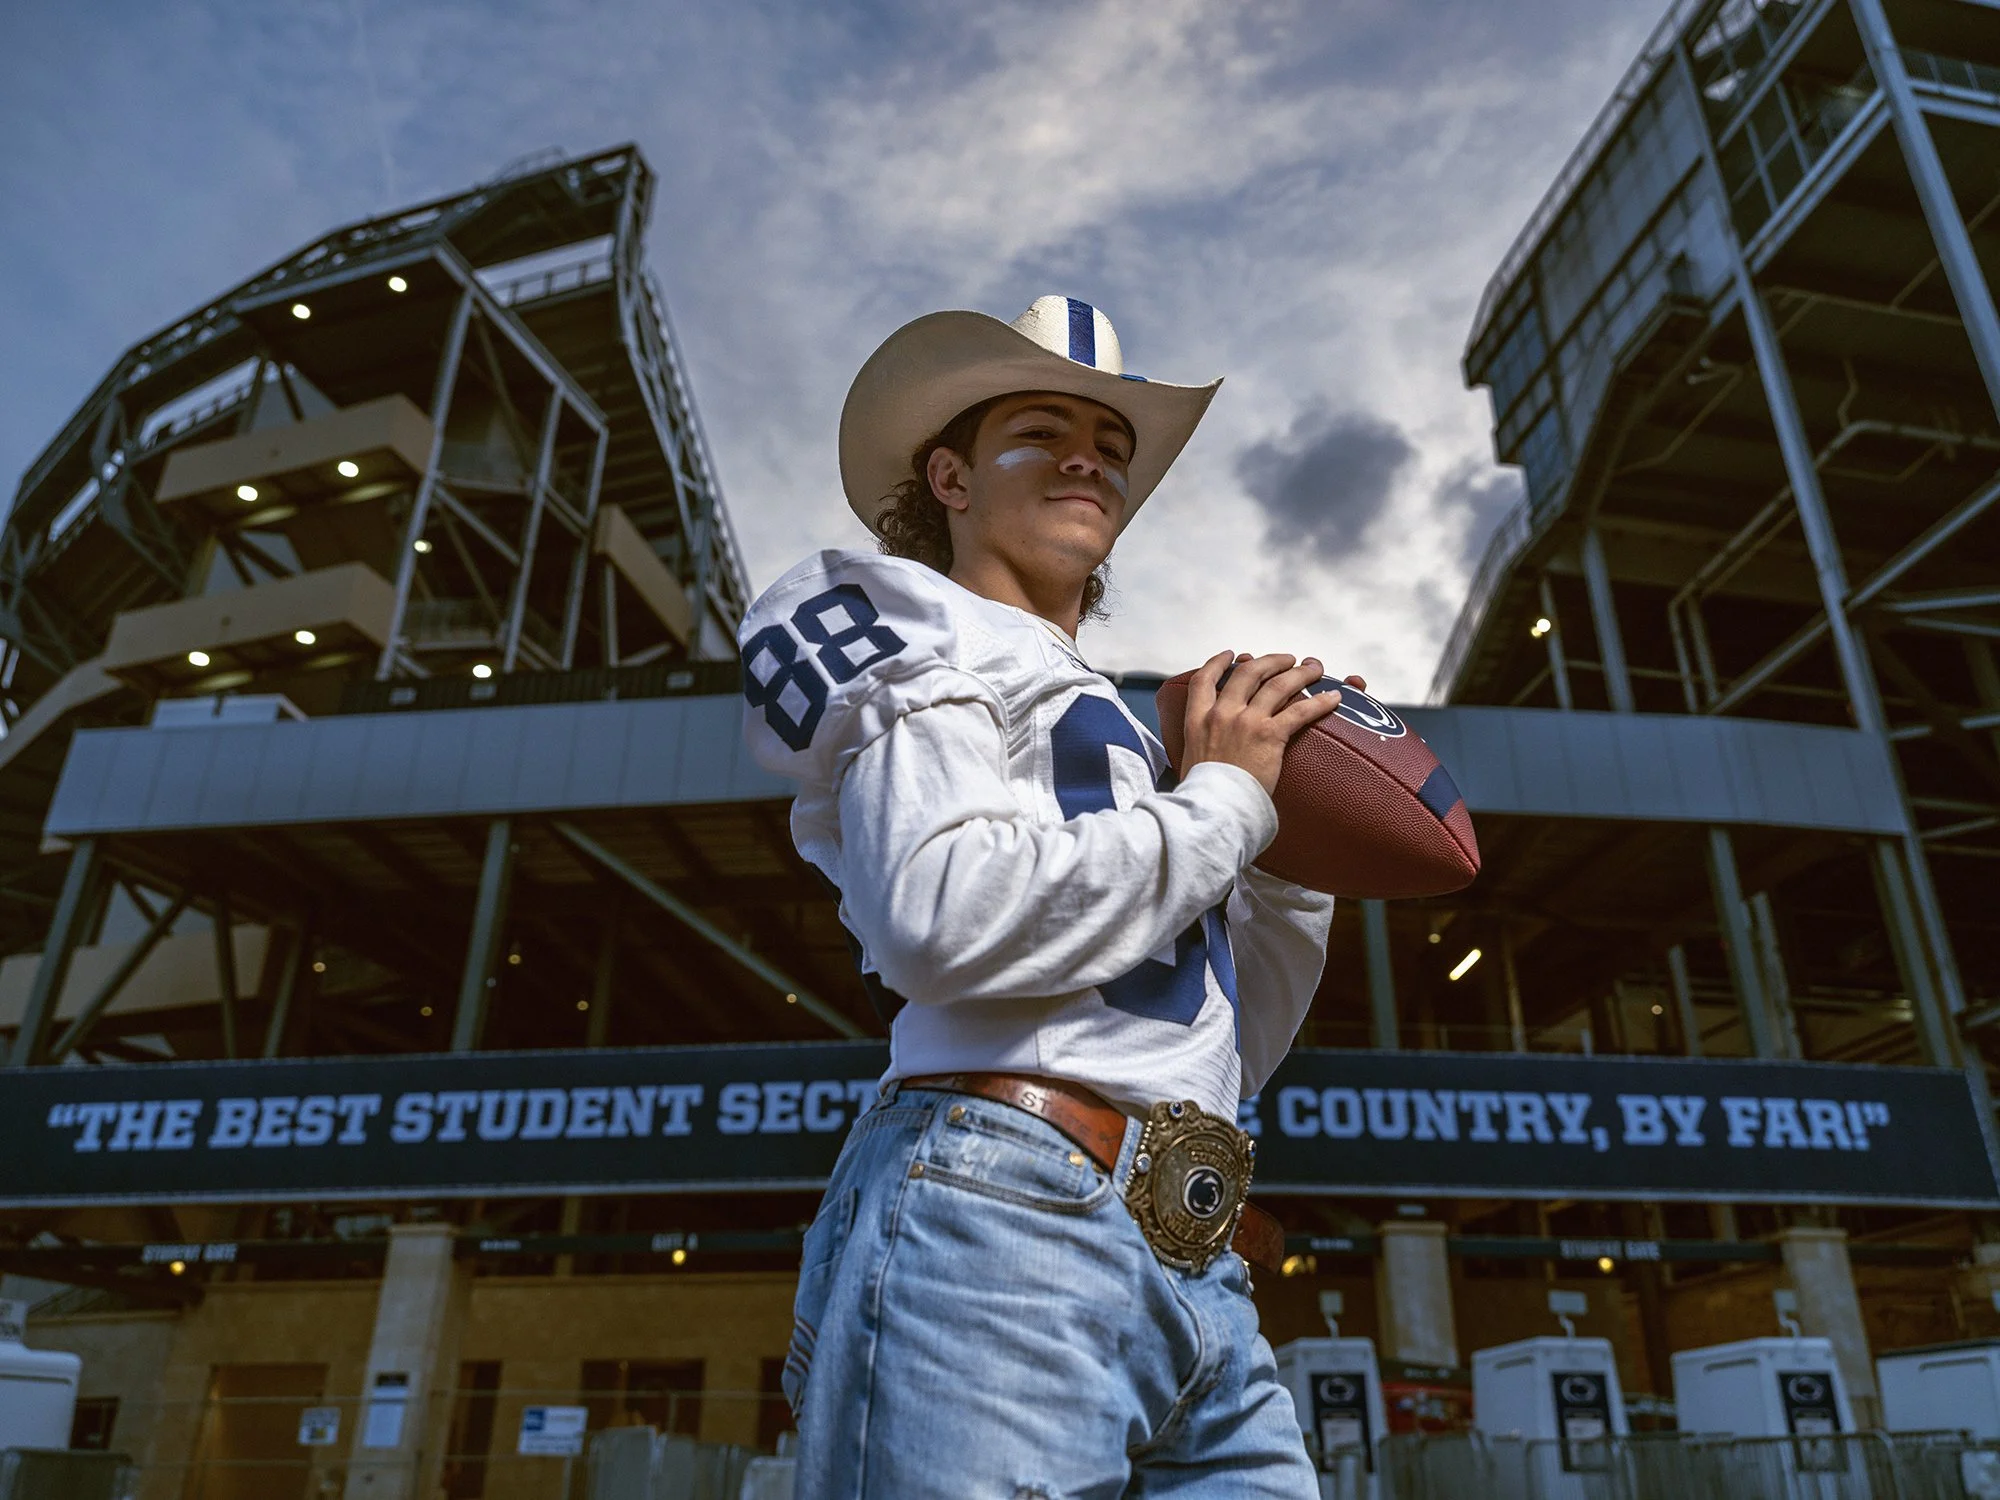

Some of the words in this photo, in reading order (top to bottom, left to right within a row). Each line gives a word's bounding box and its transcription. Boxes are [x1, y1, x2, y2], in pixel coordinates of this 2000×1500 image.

[741, 584, 908, 752] 88
[208, 1094, 381, 1149] BEST
[390, 1084, 704, 1143] STUDENT
[1277, 1086, 1609, 1152] COUNTRY,
[1616, 1094, 1706, 1146] BY
